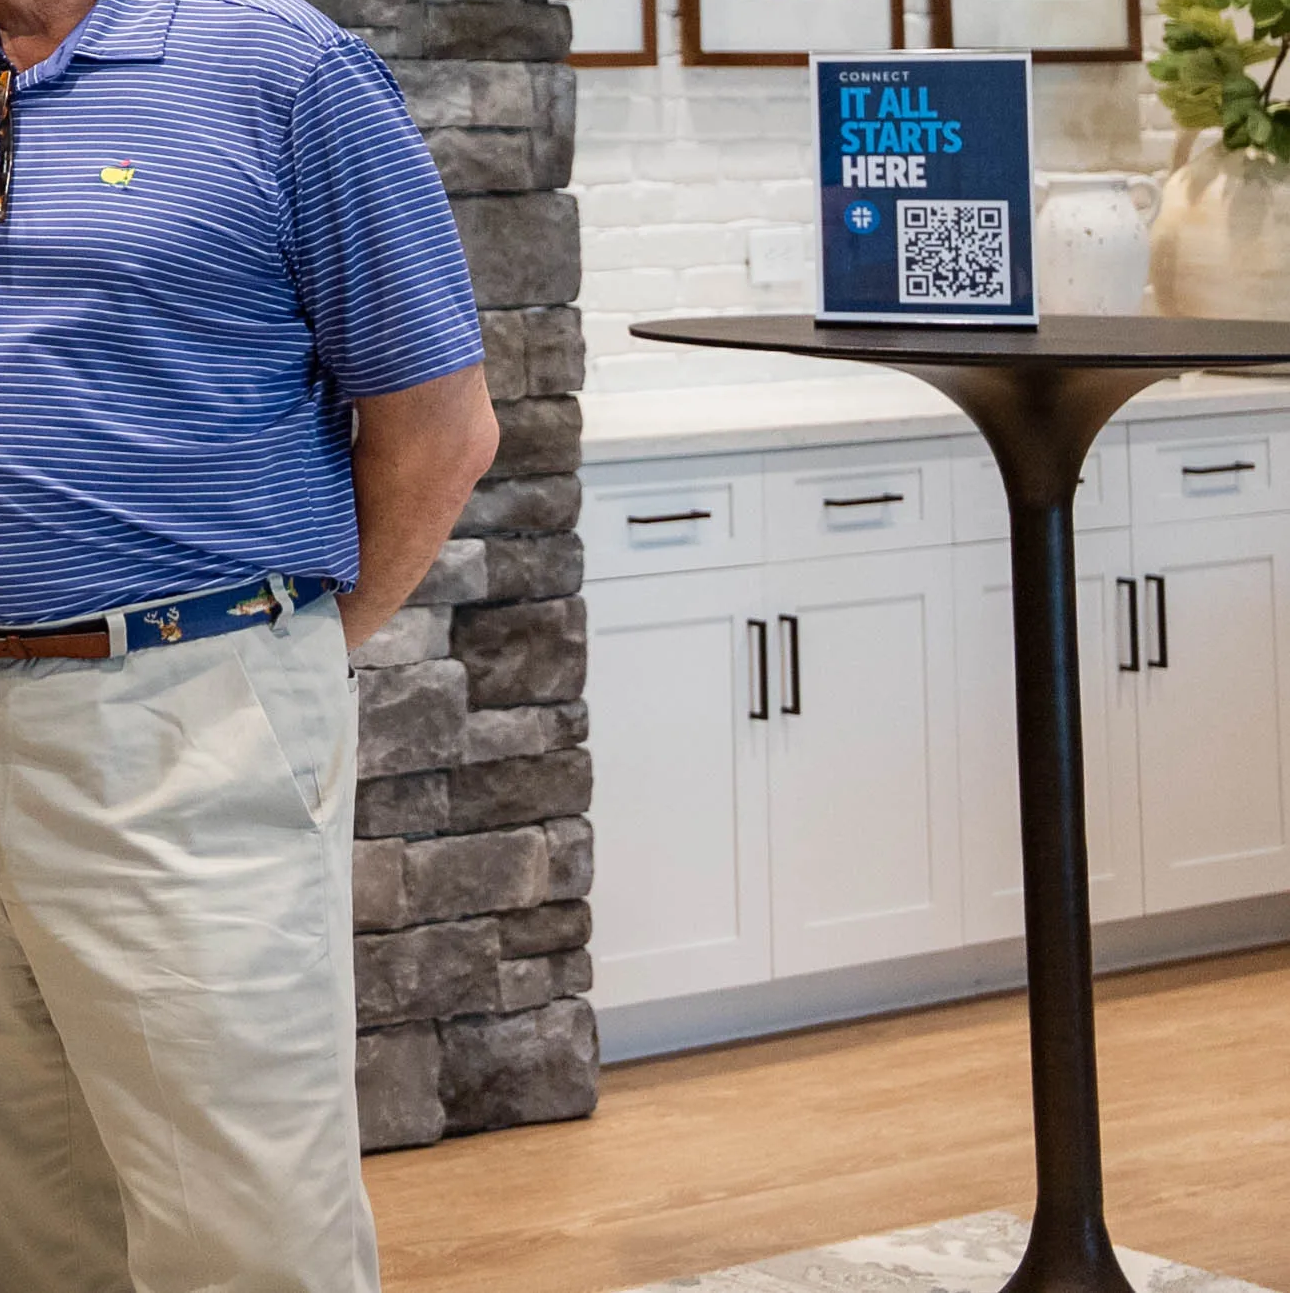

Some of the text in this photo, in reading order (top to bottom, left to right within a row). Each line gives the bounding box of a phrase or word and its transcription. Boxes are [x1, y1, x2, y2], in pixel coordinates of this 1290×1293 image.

[839, 71, 910, 82] CONNECT
[840, 86, 938, 119] IT ALL
[840, 121, 962, 153] STARTS
[842, 155, 927, 188] HERE
